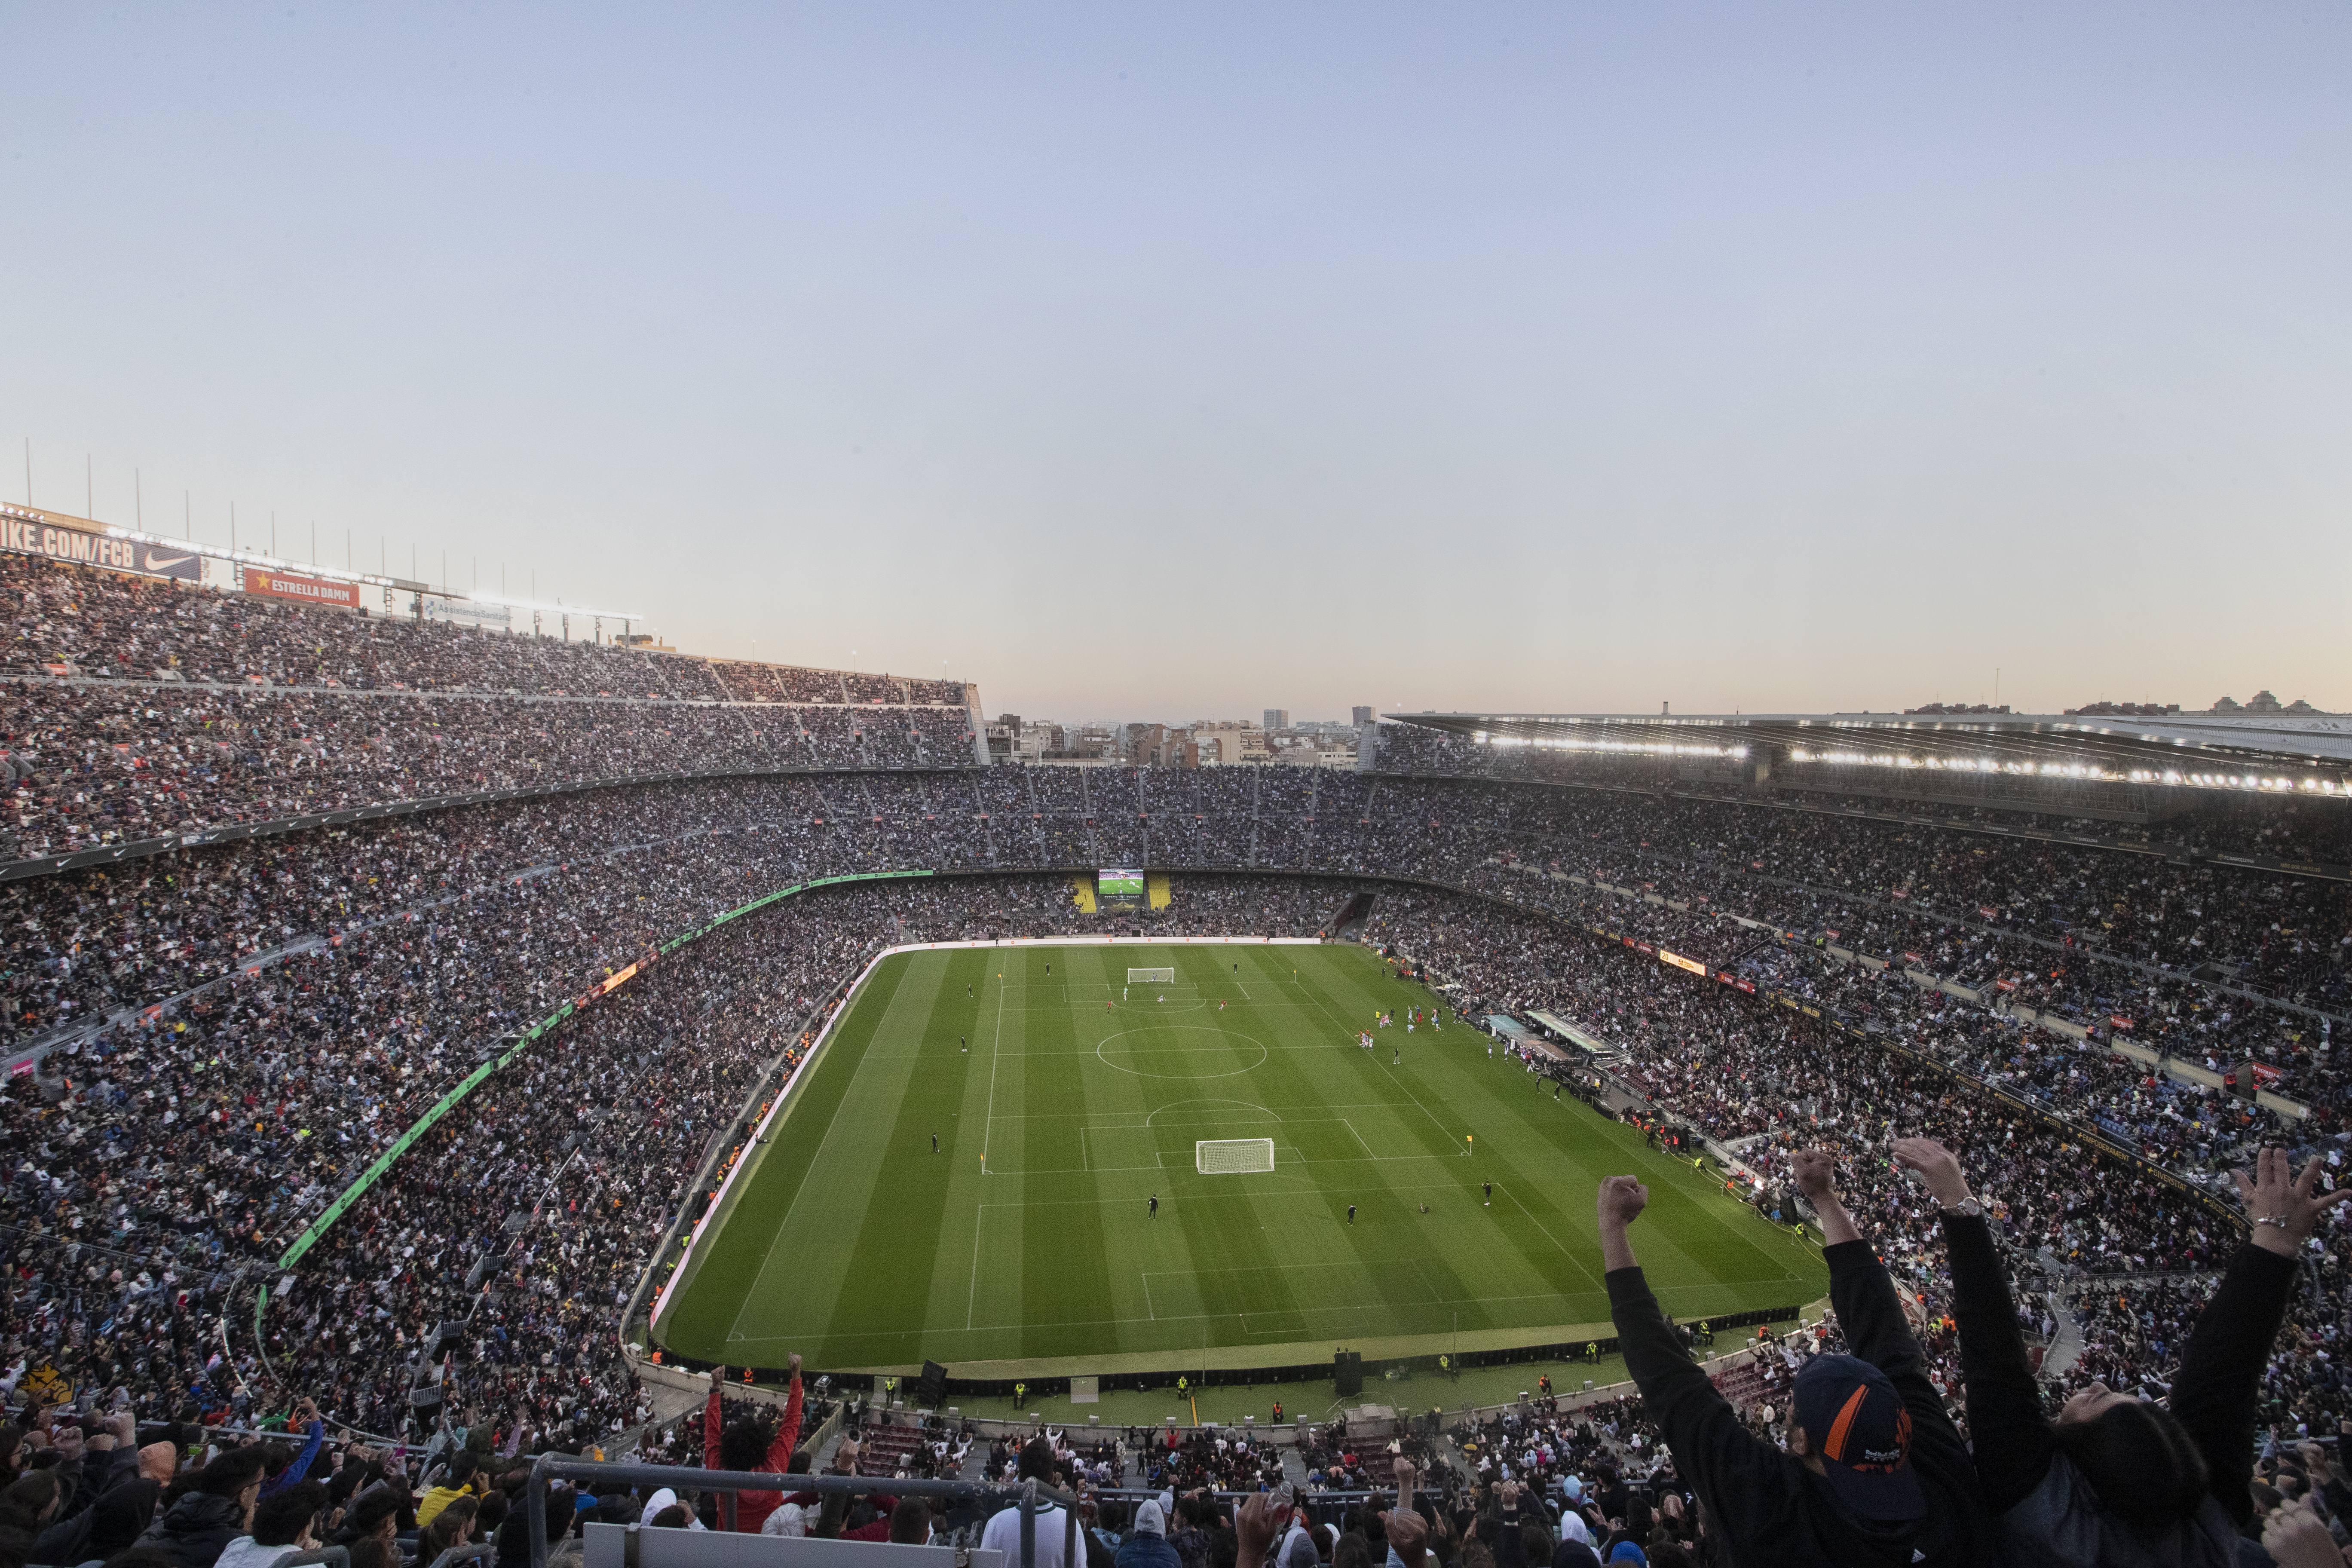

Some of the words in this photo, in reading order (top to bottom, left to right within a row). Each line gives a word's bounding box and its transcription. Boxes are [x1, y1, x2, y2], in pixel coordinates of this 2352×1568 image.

[272, 579, 319, 597] ESTRELLA
[321, 587, 350, 601] DAMM
[1662, 952, 1669, 960] 20
